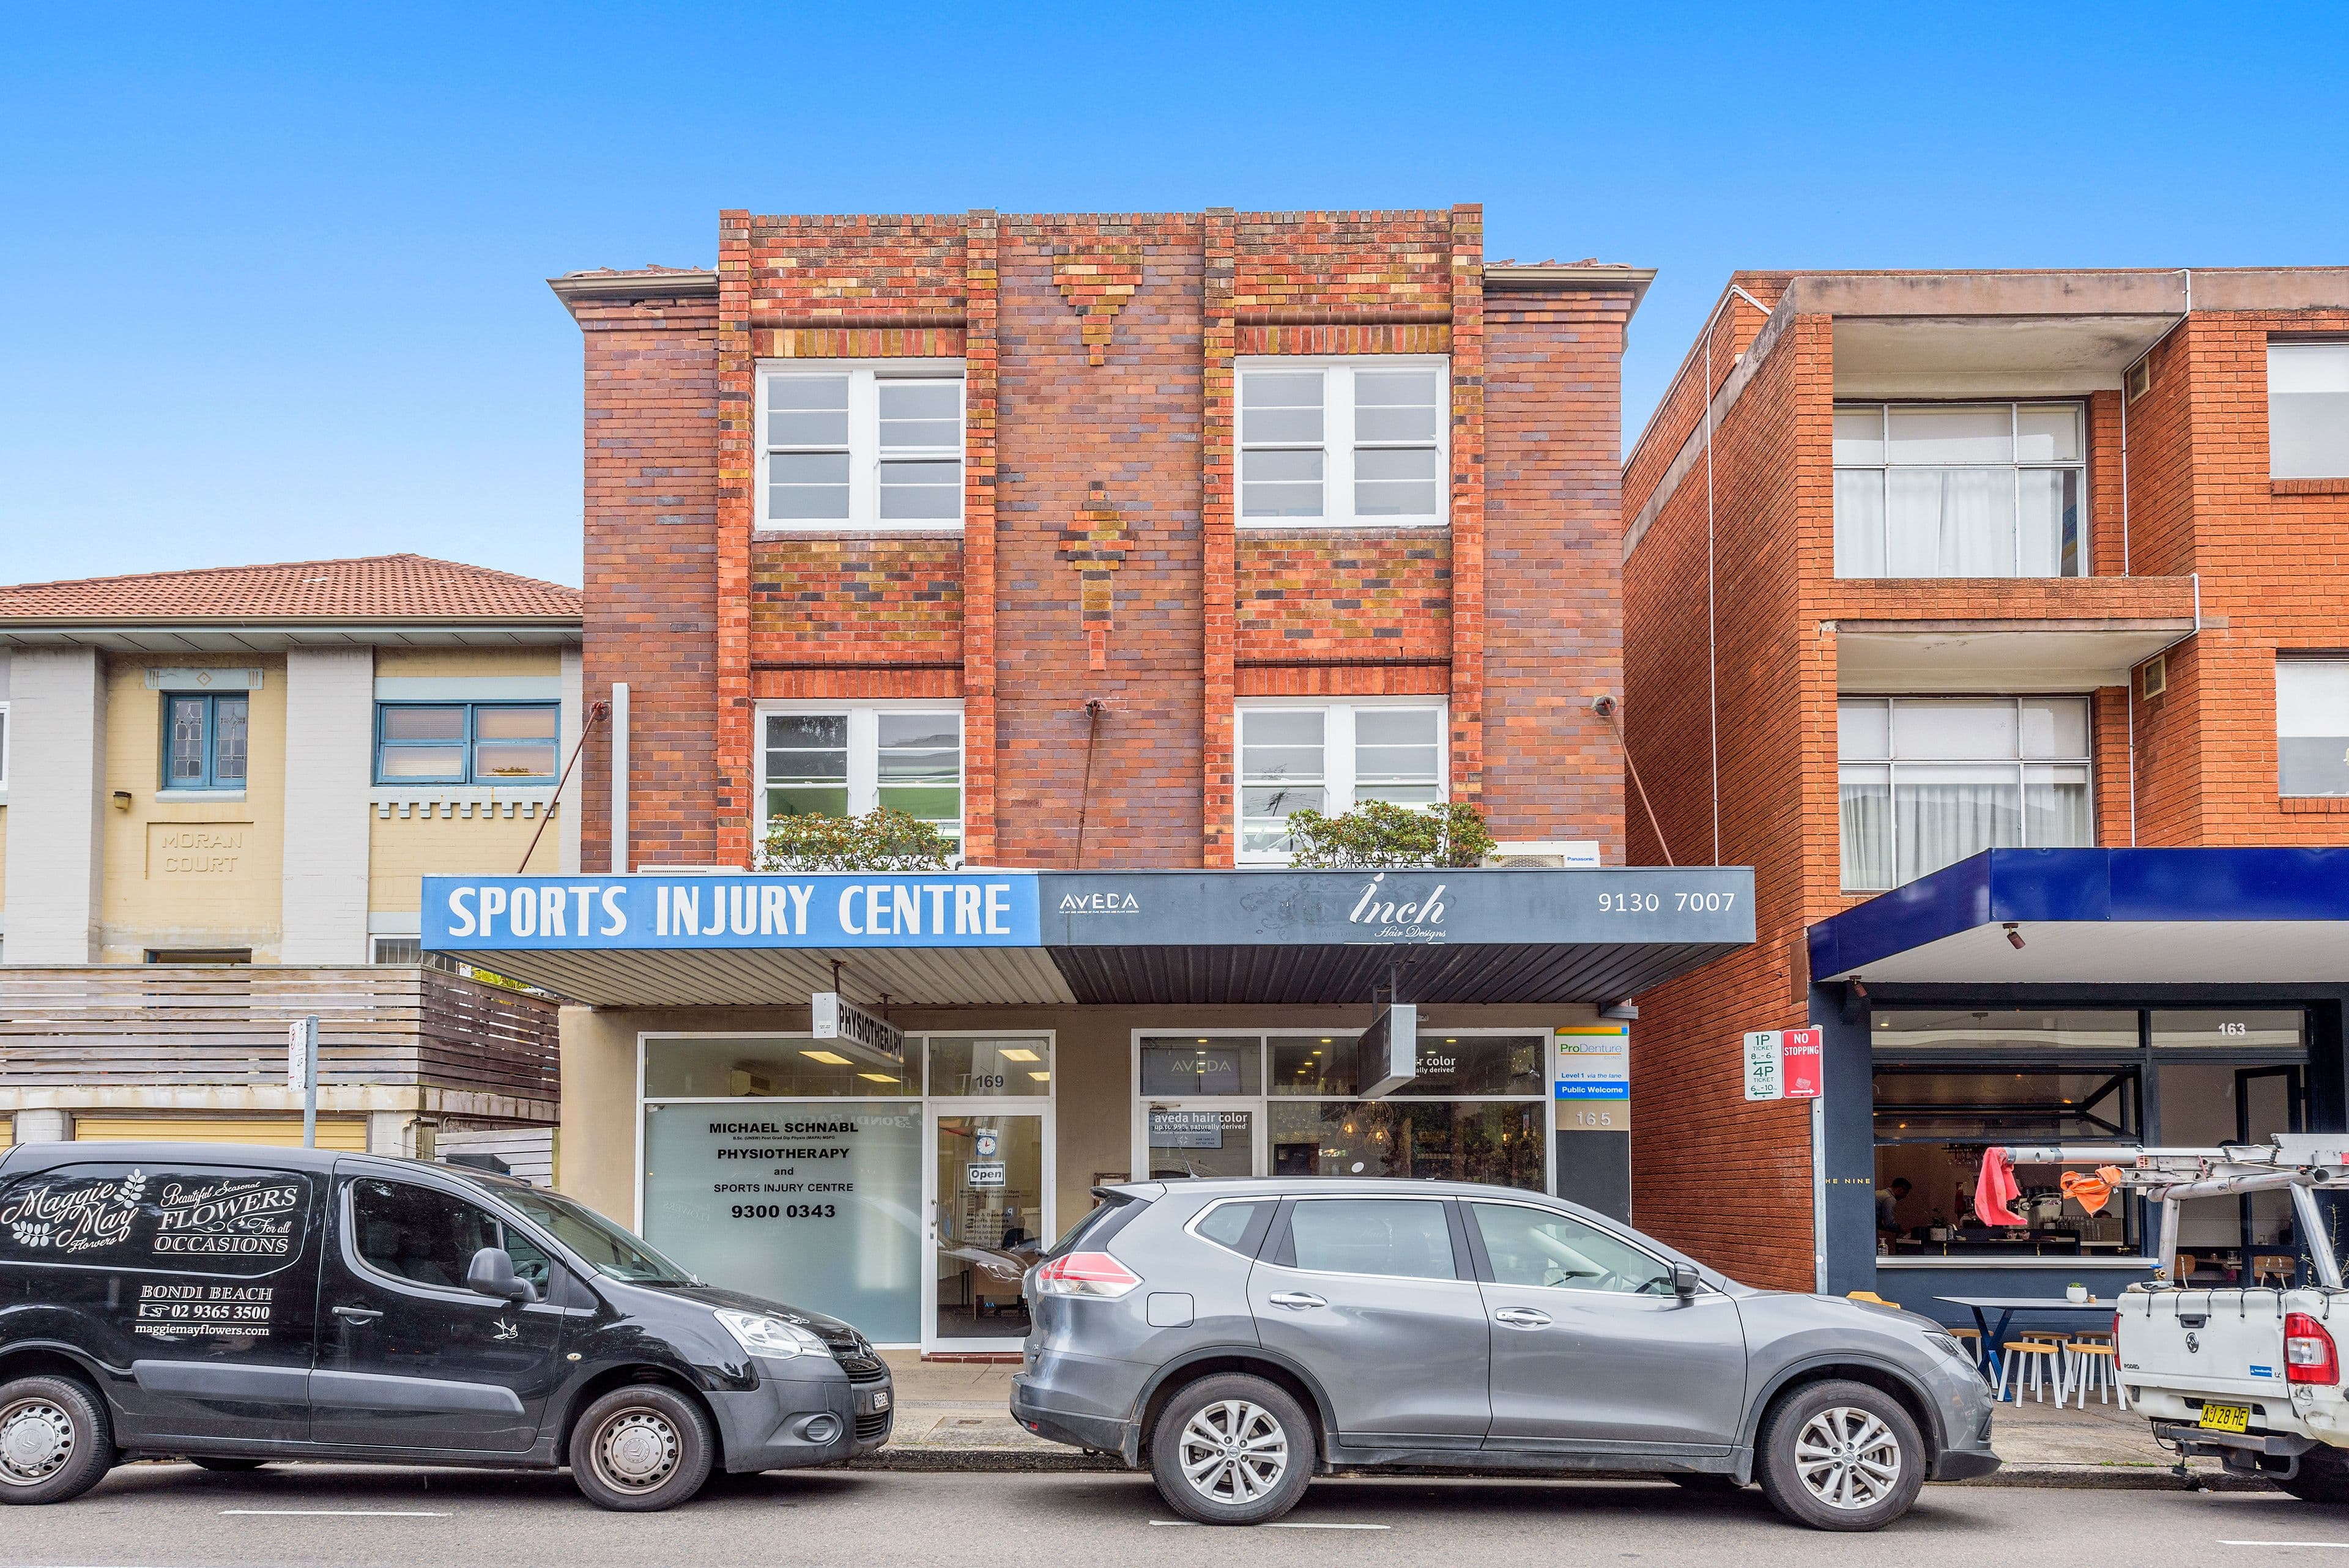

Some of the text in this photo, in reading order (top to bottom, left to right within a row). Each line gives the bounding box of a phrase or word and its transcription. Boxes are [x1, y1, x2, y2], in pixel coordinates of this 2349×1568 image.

[162, 832, 242, 848] MORAN
[165, 856, 238, 872] COURT
[1059, 892, 1139, 909] AVEDA
[1598, 893, 1735, 912] 9130 7007
[448, 883, 1011, 939] SPORTS INJURY CENTRE
[1374, 925, 1446, 941] Hair Designs
[839, 1003, 902, 1058] PHYSIOTHERAPY
[2219, 1023, 2246, 1035] 163
[1756, 1034, 1770, 1046] 1P
[1794, 1033, 1809, 1044] NO
[1560, 1044, 1622, 1052] ProDenture
[1784, 1045, 1819, 1056] STOPPING
[1171, 1060, 1231, 1071] AVEDA
[1427, 1056, 1456, 1066] color
[1753, 1066, 1773, 1077] 4P
[976, 1075, 1004, 1087] 169
[1155, 1112, 1189, 1123] aveda
[1193, 1112, 1215, 1123] hair
[1219, 1112, 1248, 1123] color
[1576, 1111, 1611, 1126] 165
[710, 1122, 858, 1133] MICHAEL SCHNABL
[718, 1148, 850, 1159] PHYSIOTHERAPY
[774, 1167, 794, 1175] and
[971, 1170, 1001, 1180] Open
[160, 1180, 261, 1208] Beautiful Seasonal
[714, 1183, 853, 1193] SPORTS INJURY CENTRE
[1, 1182, 117, 1224] Maggie
[158, 1188, 298, 1230] FLOWERS
[732, 1205, 836, 1218] 9300 0343
[56, 1202, 139, 1248] May
[247, 1218, 292, 1235] For all
[67, 1237, 117, 1253] Flowers
[154, 1236, 288, 1252] OCCASIONS
[140, 1285, 273, 1301] BONDI BEACH
[171, 1304, 270, 1319] 02 9365 3500
[135, 1323, 269, 1337] maggiemayflowers.com
